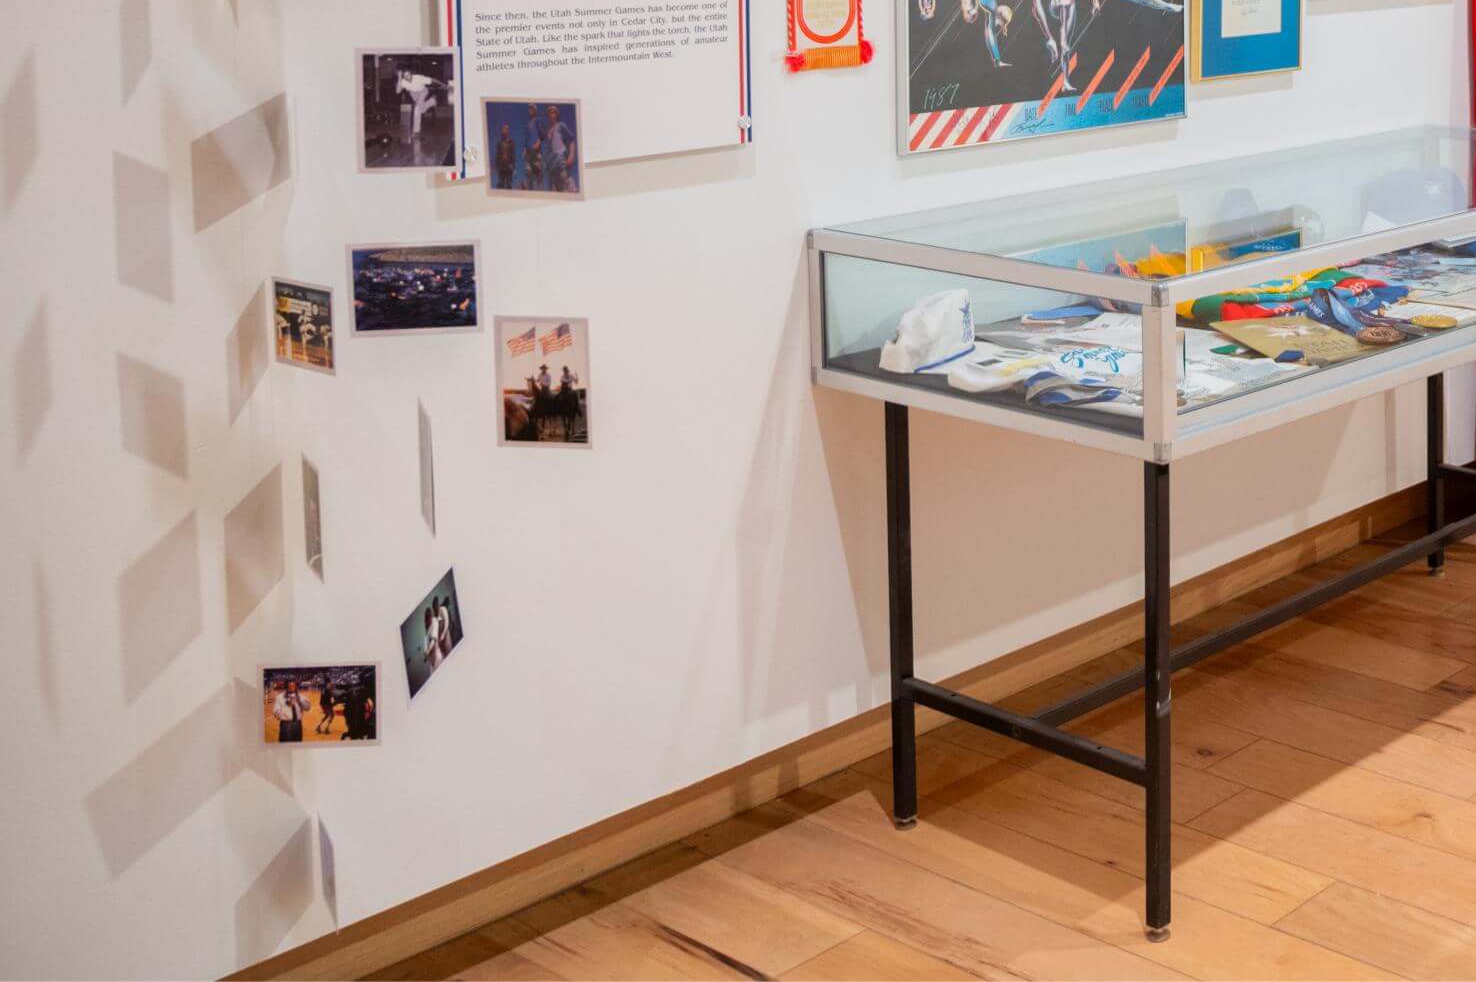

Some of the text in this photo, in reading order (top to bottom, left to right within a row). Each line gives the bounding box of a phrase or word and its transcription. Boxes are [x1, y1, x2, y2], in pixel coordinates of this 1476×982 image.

[475, 37, 501, 47] State
[503, 36, 514, 45] of
[542, 34, 562, 43] Like
[564, 32, 579, 41] the
[580, 31, 606, 41] spark
[607, 30, 625, 39] that
[627, 28, 650, 39] lights
[652, 27, 666, 36] the
[694, 24, 708, 33] the
[709, 23, 728, 32] Utah
